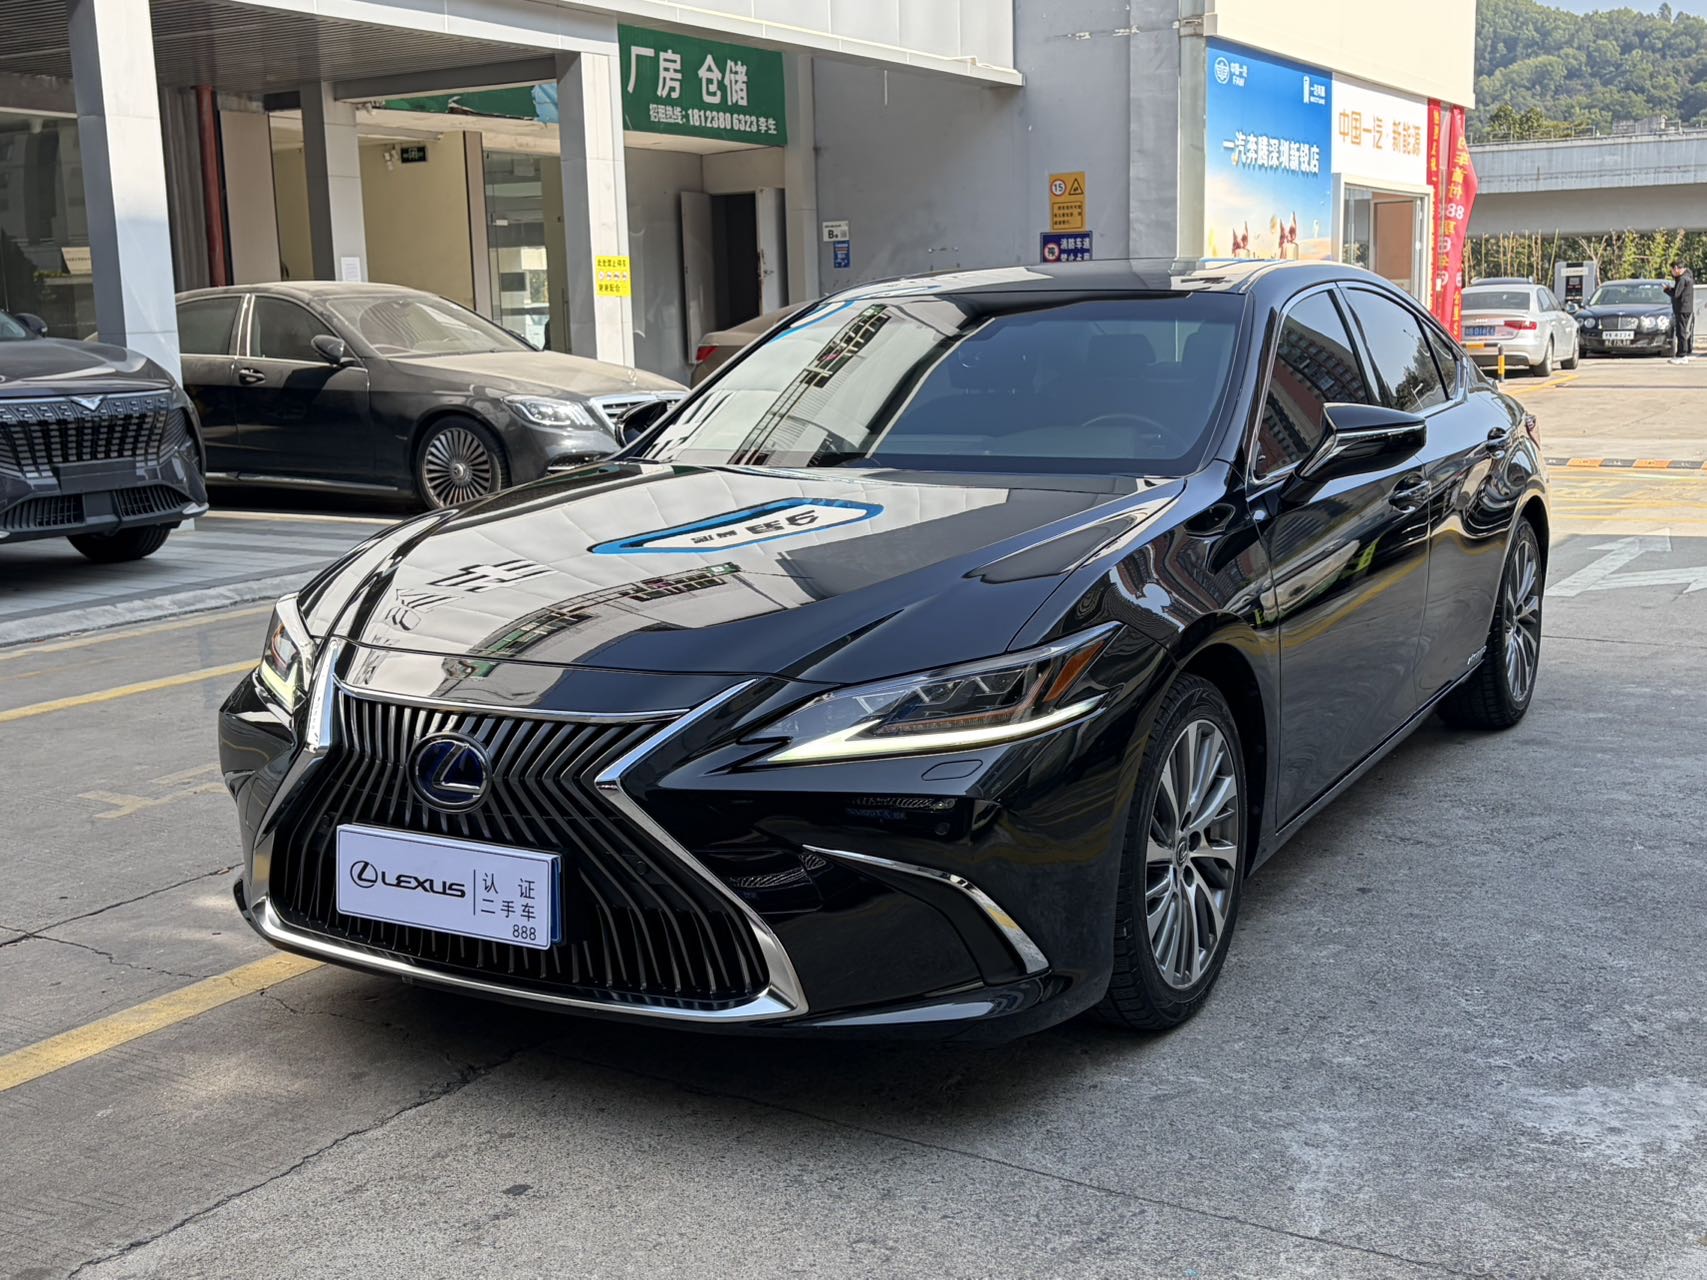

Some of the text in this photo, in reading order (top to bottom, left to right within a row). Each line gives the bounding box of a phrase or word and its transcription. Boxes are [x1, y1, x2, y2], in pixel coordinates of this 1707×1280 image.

[627, 45, 748, 106] 厂房 仓储
[1053, 182, 1064, 192] 15
[1060, 237, 1090, 249] 消防车道
[381, 871, 467, 899] LEXUS
[482, 872, 536, 900] 认证
[480, 898, 537, 922] 二手车
[512, 924, 537, 941] 888
